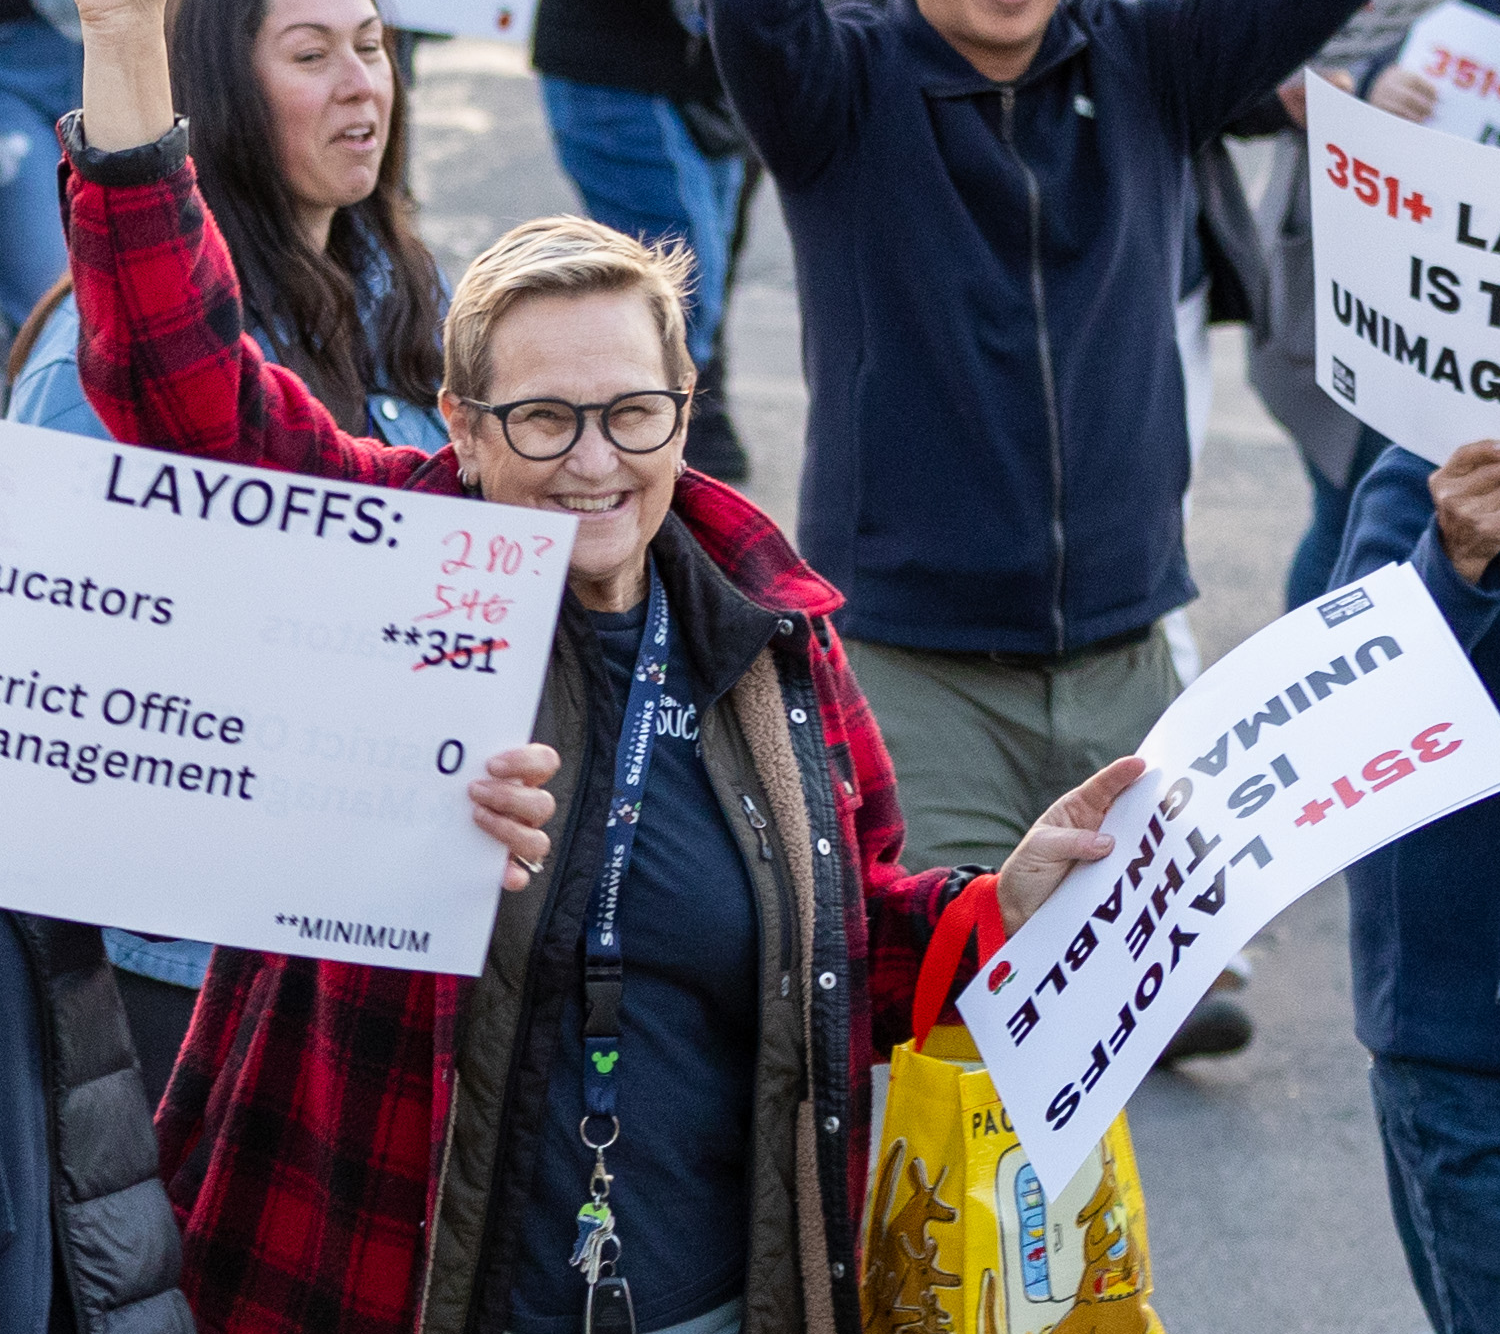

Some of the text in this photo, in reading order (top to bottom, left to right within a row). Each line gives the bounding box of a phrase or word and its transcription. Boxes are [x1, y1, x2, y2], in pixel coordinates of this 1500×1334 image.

[1326, 143, 1432, 224] 351+
[1408, 256, 1461, 315] IS
[105, 454, 405, 547] LAYOFFS:
[102, 687, 245, 745] Office
[436, 739, 464, 775] 0
[626, 699, 655, 786] SEAHAWKS
[1006, 635, 1404, 1047] UNIMAGINABLE
[1125, 754, 1300, 962] IS THE
[600, 844, 625, 946] SEAHAWKS
[1045, 722, 1464, 1132] 351+ LAYOFFS
